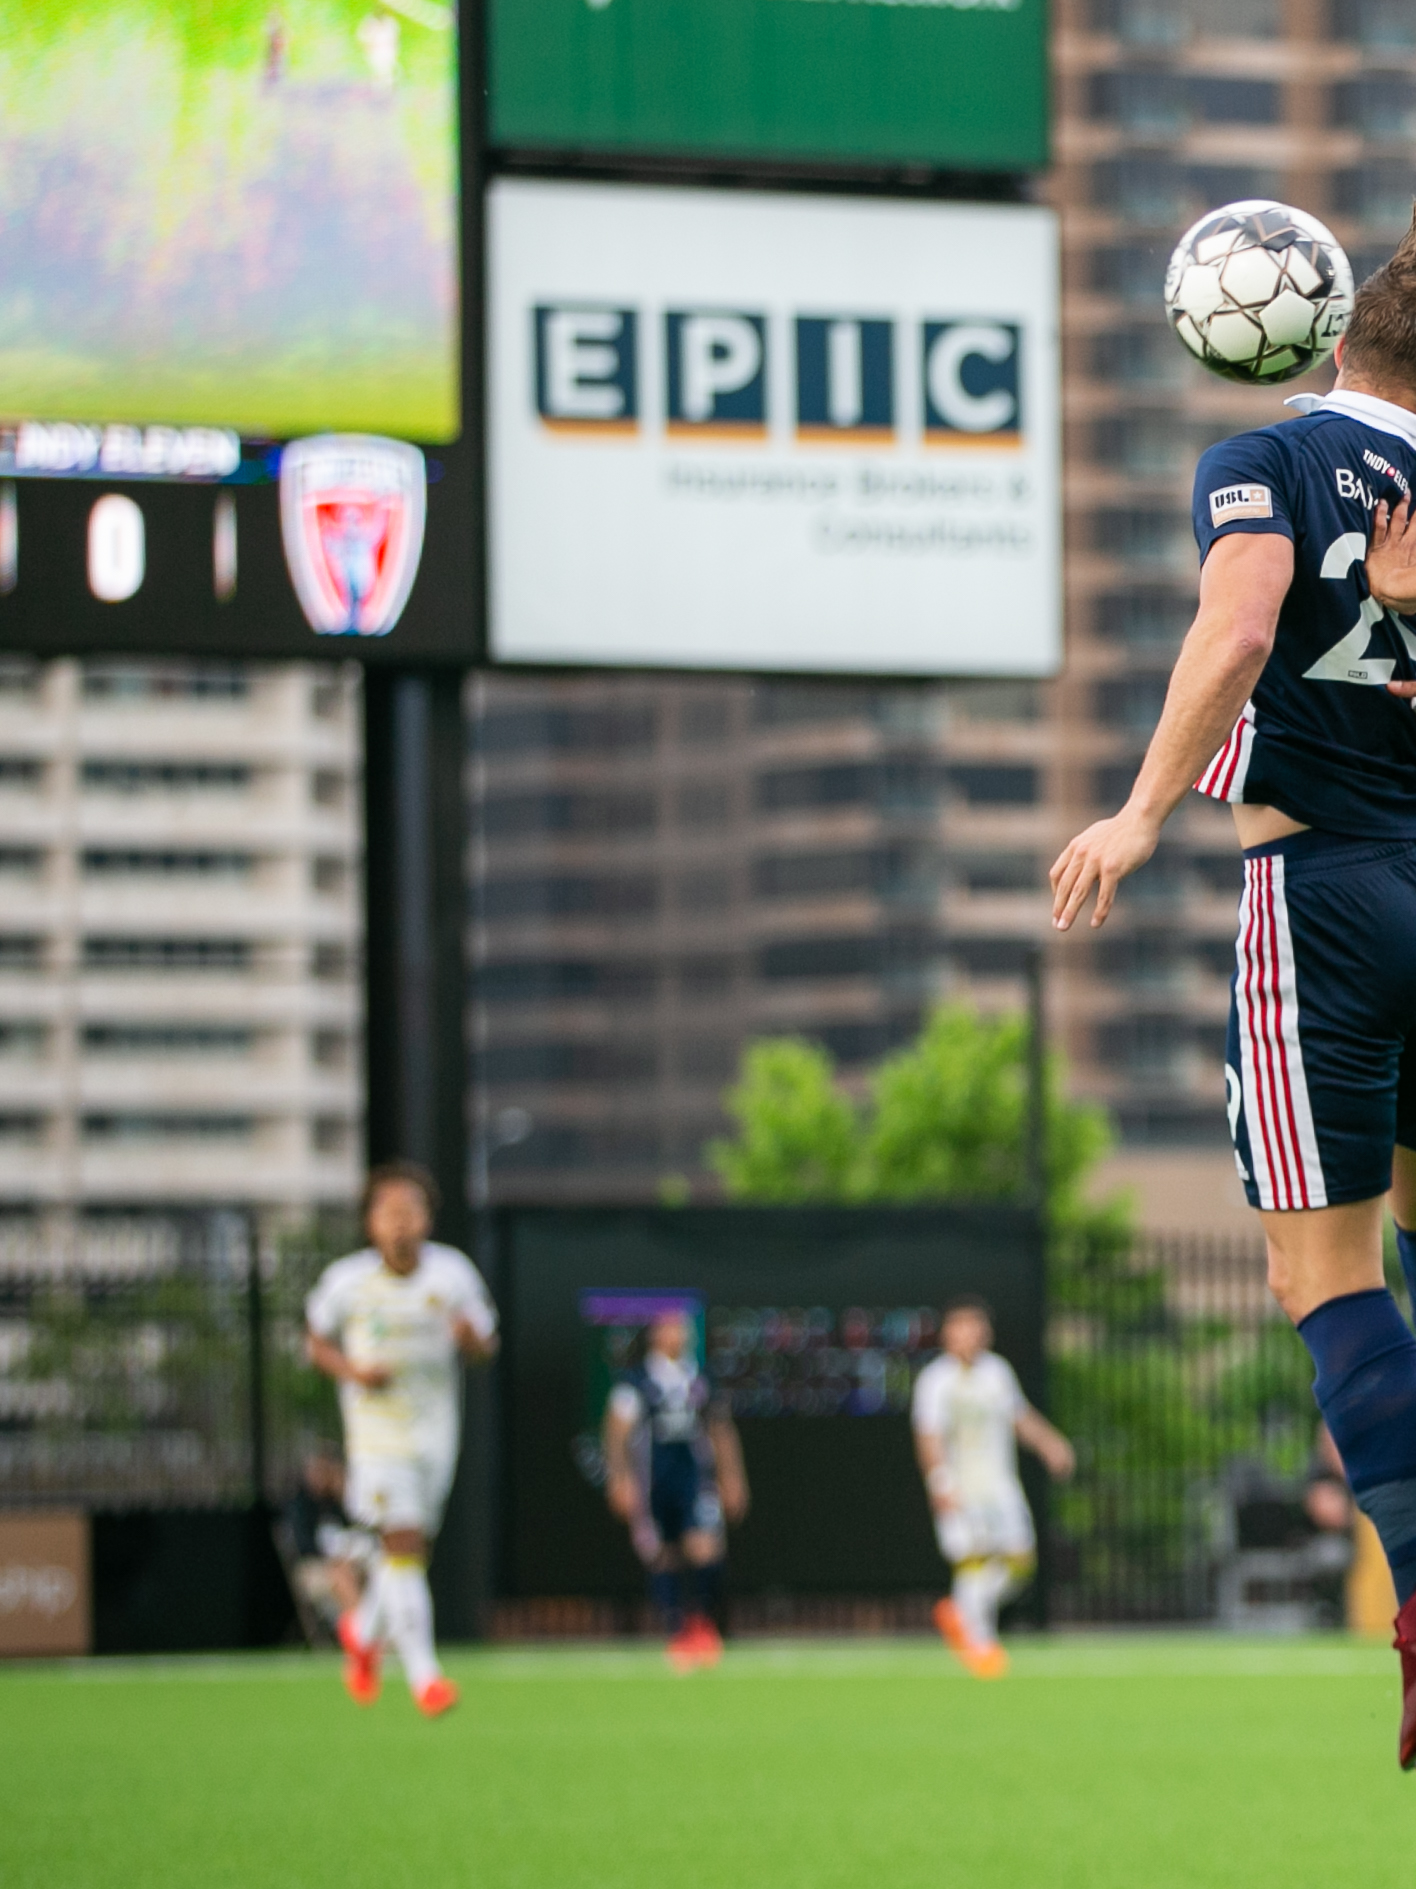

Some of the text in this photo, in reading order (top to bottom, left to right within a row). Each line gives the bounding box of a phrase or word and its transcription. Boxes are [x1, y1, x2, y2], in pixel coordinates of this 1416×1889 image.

[541, 309, 1017, 434] EPIC
[1362, 448, 1391, 474] INDY
[1214, 489, 1249, 509] USL
[87, 493, 145, 603] 0
